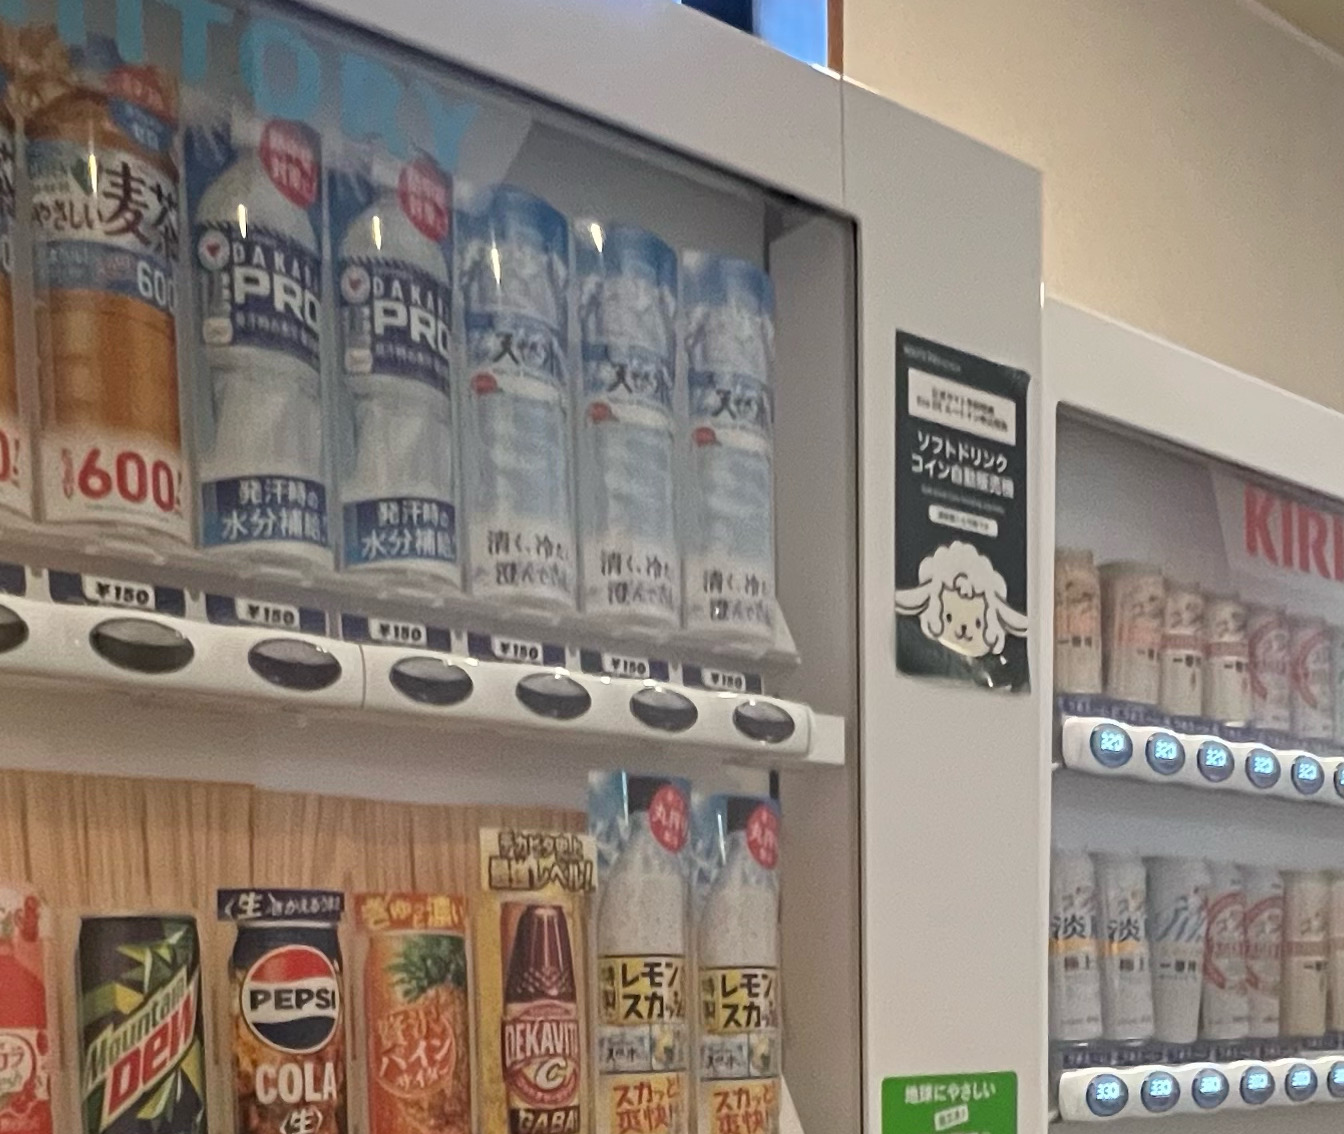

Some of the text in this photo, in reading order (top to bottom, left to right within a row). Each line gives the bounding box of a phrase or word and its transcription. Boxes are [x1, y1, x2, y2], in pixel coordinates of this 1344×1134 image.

[917, 429, 1008, 474] ソフトドリンク
[249, 988, 338, 1012] PEPSI
[255, 1061, 338, 1105] COLA
[904, 1080, 997, 1105] 地球にやさしい
